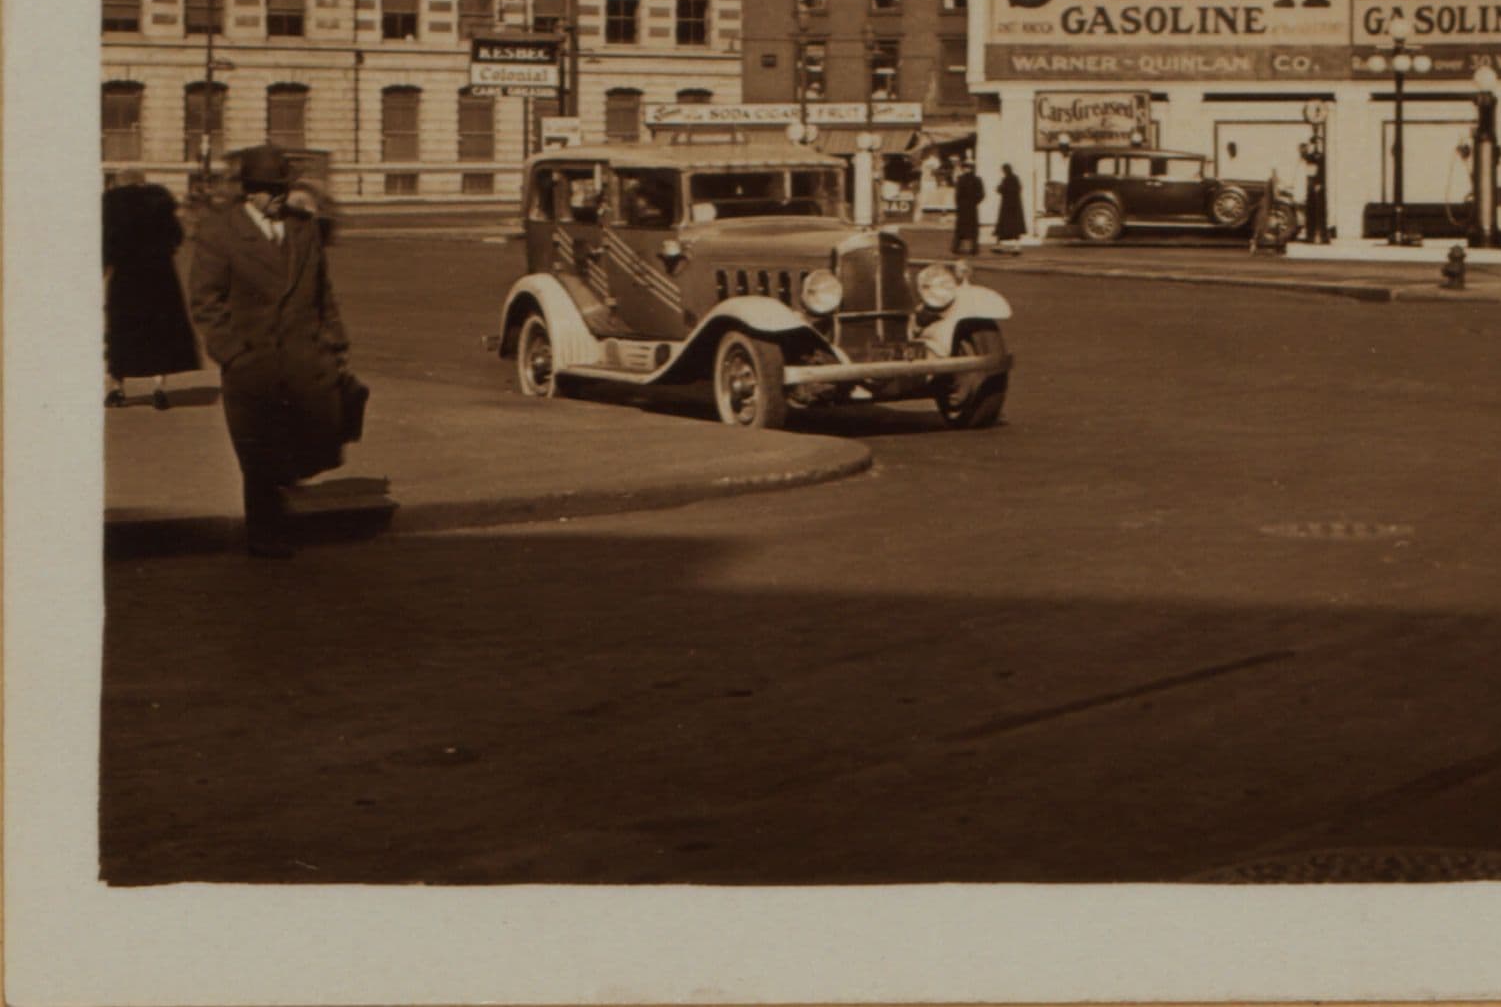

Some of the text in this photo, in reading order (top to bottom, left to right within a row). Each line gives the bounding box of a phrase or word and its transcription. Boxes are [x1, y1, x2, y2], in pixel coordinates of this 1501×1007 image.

[1061, 6, 1266, 34] GASOLINE
[480, 67, 549, 82] Colonial
[1273, 56, 1320, 72] CO.
[1038, 97, 1072, 123] Cars
